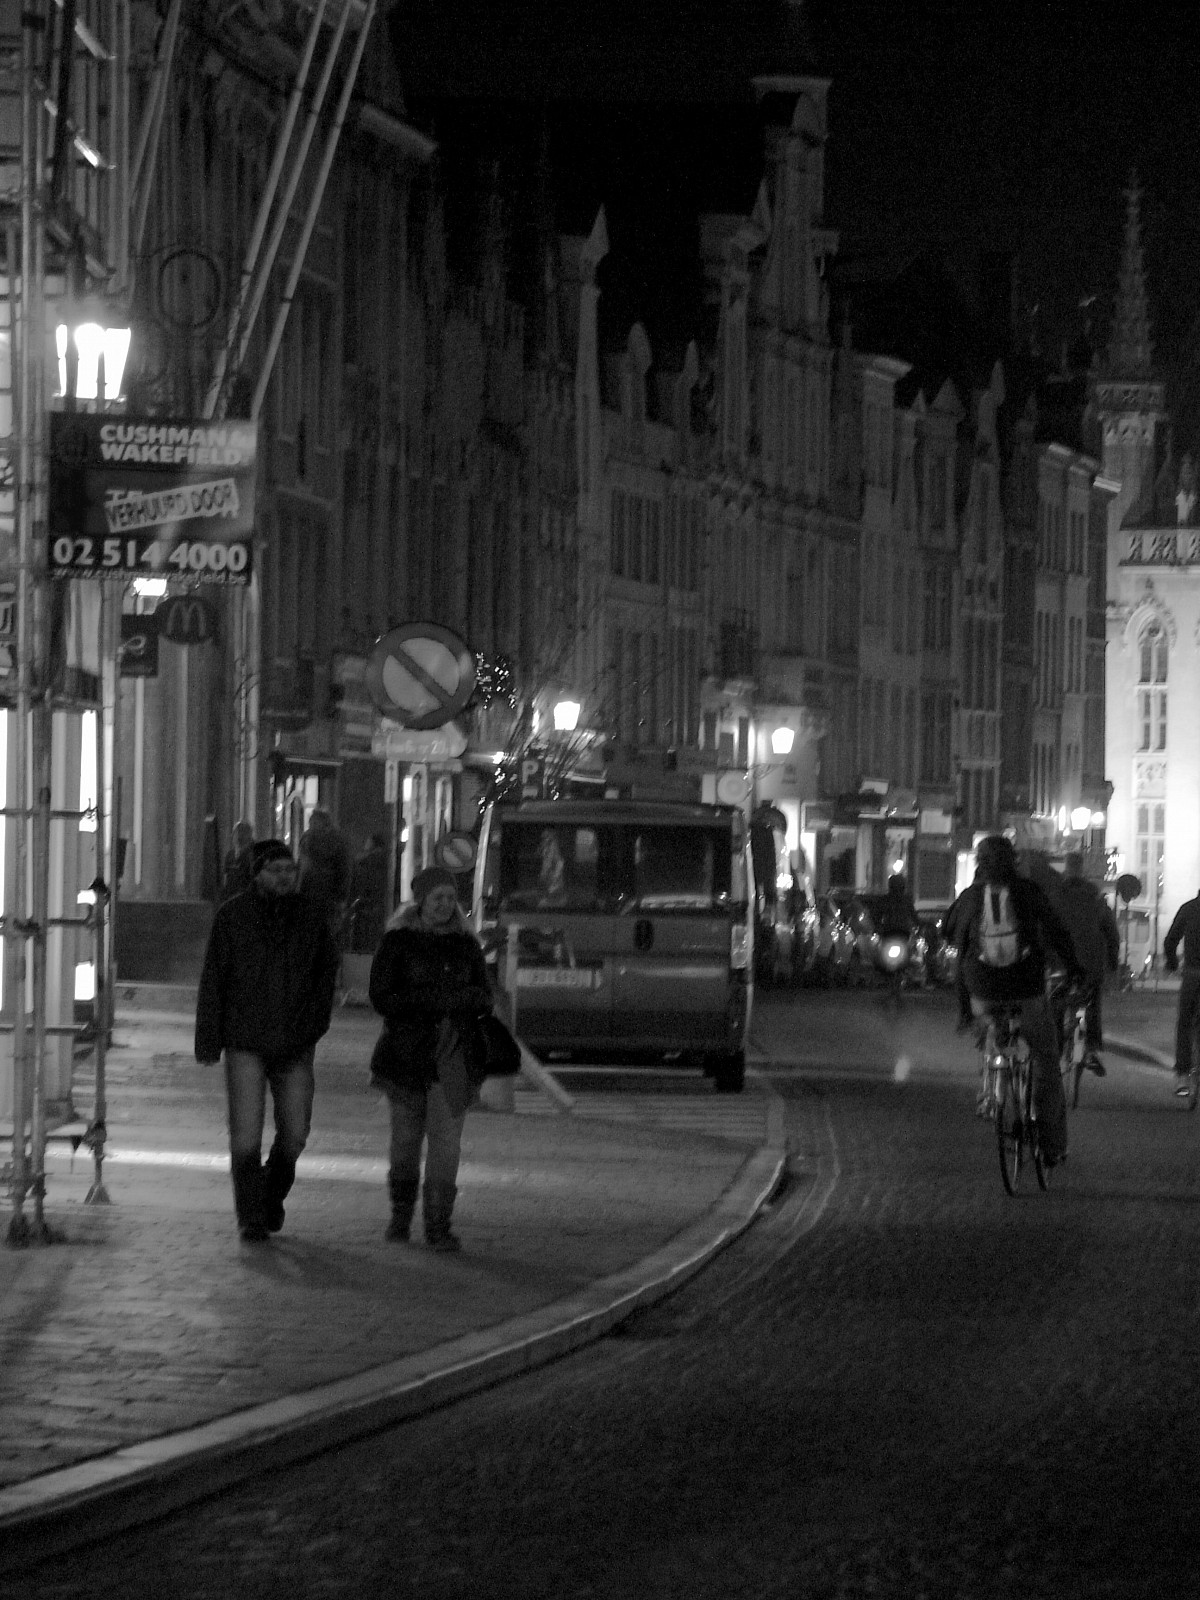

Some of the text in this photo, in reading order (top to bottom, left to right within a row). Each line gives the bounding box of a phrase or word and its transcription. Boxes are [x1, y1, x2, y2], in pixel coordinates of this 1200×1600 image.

[99, 424, 228, 447] CUSHMAN
[99, 443, 243, 466] WAKEFIELD
[52, 536, 248, 573] 02 514 4000
[521, 760, 540, 785] P
